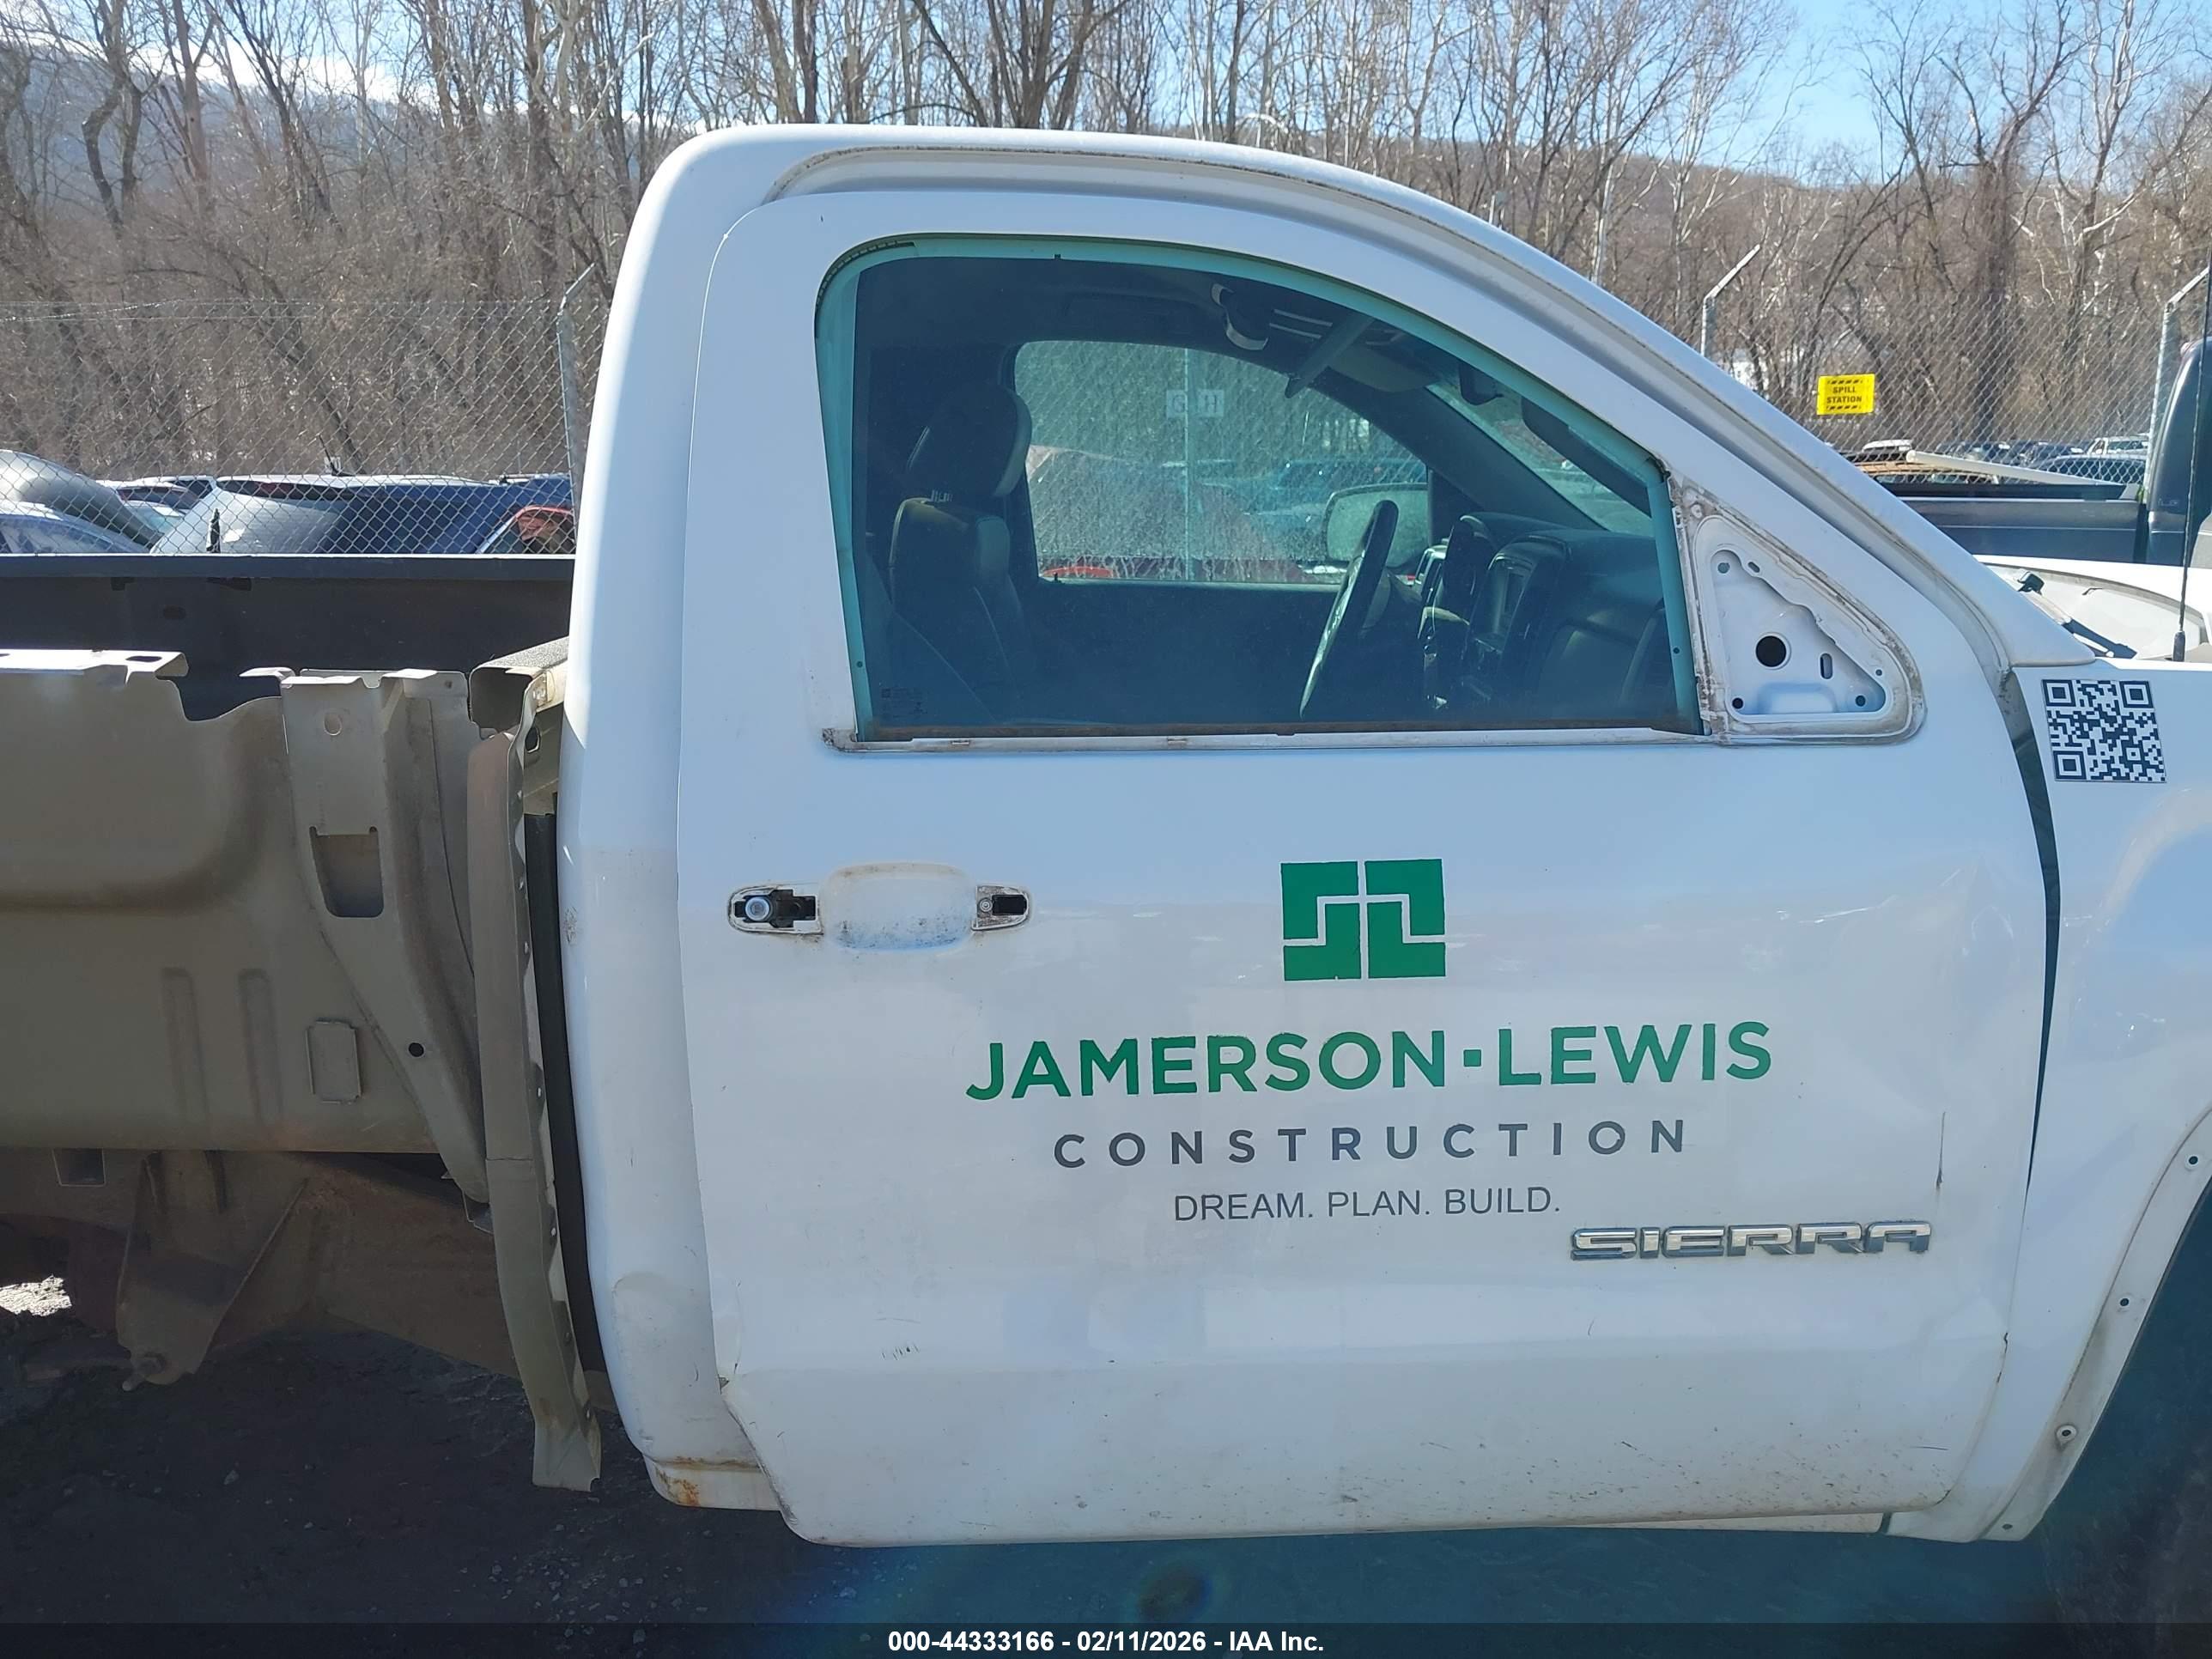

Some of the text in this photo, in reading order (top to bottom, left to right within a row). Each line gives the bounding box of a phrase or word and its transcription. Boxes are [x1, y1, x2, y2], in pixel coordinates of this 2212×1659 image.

[1054, 1119, 1684, 1169] CONSTRUCTION
[1175, 1186, 1560, 1222] DREAM. PLAN. BUILD.
[1571, 1219, 1931, 1261] SIERRA
